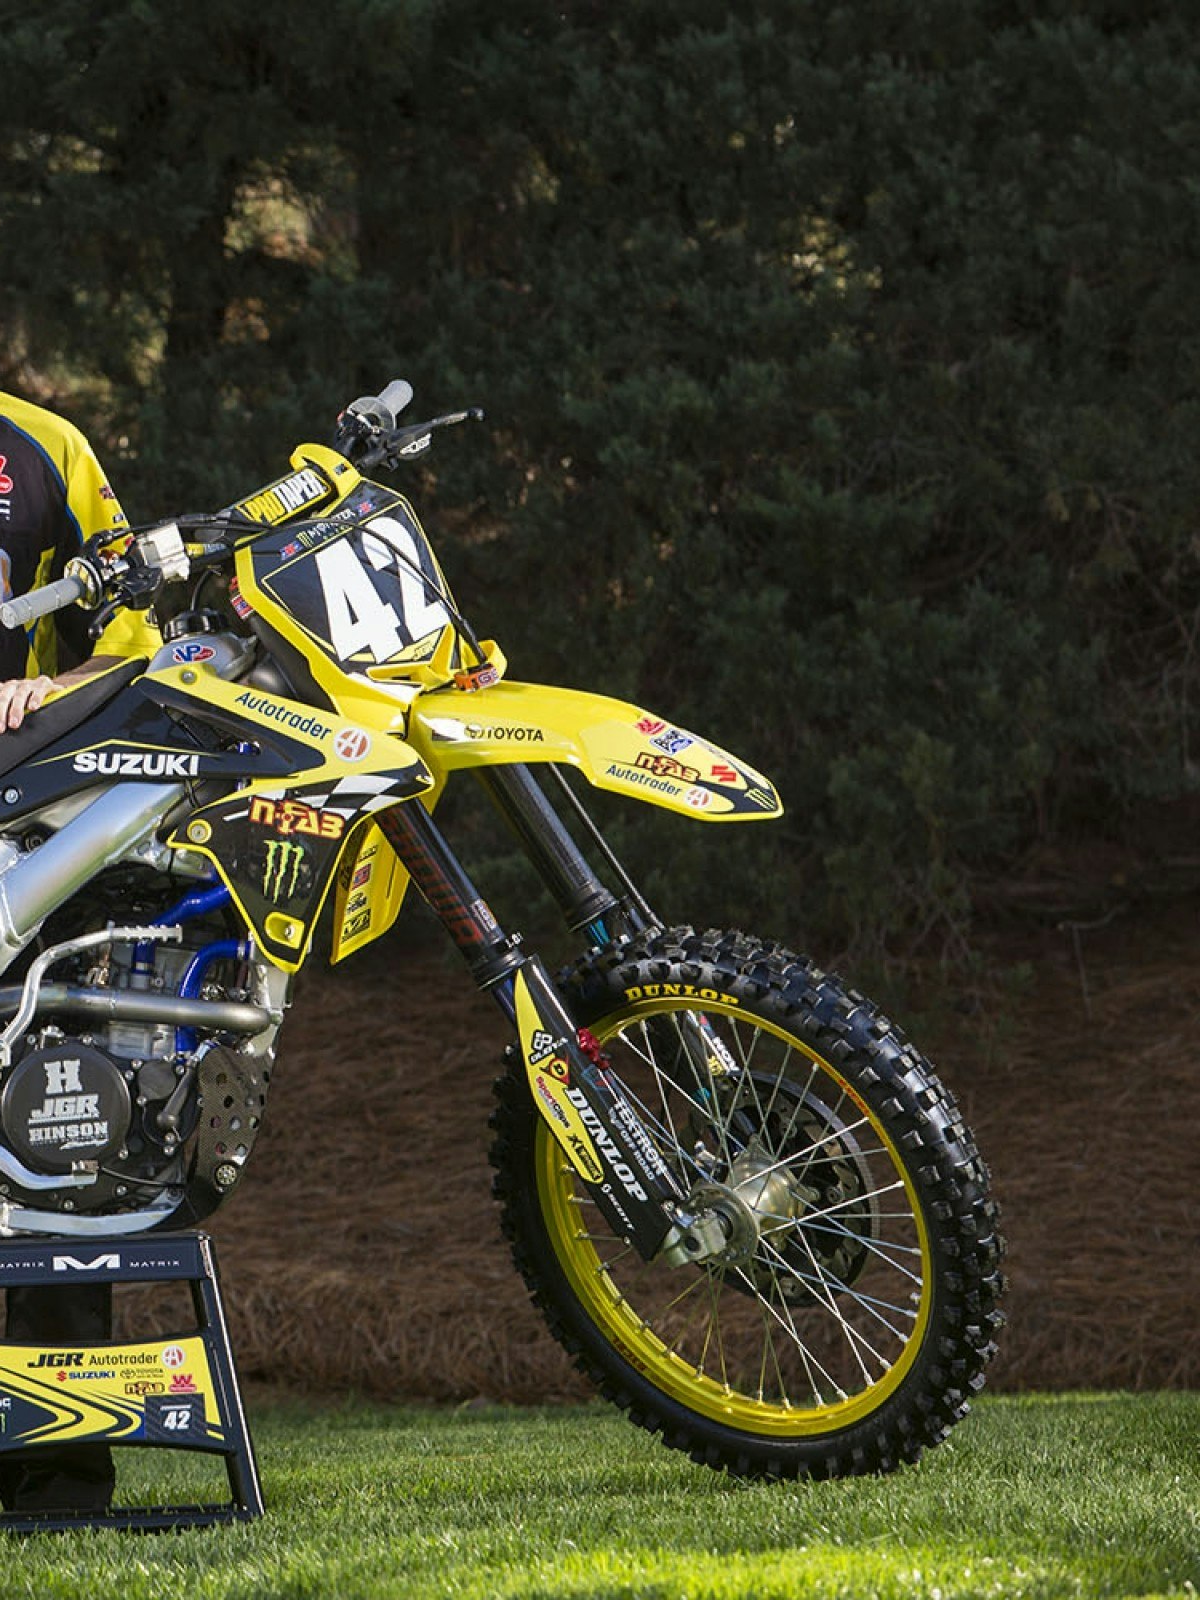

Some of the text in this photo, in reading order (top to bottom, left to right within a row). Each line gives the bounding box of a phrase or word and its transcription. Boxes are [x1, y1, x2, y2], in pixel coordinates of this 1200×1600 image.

[314, 516, 452, 665] 42
[235, 692, 332, 740] Autotrader
[486, 726, 544, 742] TOYOTA
[73, 752, 200, 777] SUZUKI
[606, 764, 683, 796] Autotrader
[624, 983, 739, 1005] DUNLOP
[44, 1058, 84, 1095] H
[31, 1094, 100, 1120] JGR
[28, 1120, 109, 1142] HINSON
[613, 1097, 668, 1177] TEXTRON
[565, 1087, 649, 1201] DUNLOP
[129, 1258, 181, 1268] MATRIX
[26, 1352, 85, 1369] JGR
[88, 1352, 159, 1368] Autotrader
[68, 1370, 116, 1380] SUZUKI
[162, 1410, 192, 1430] 42
